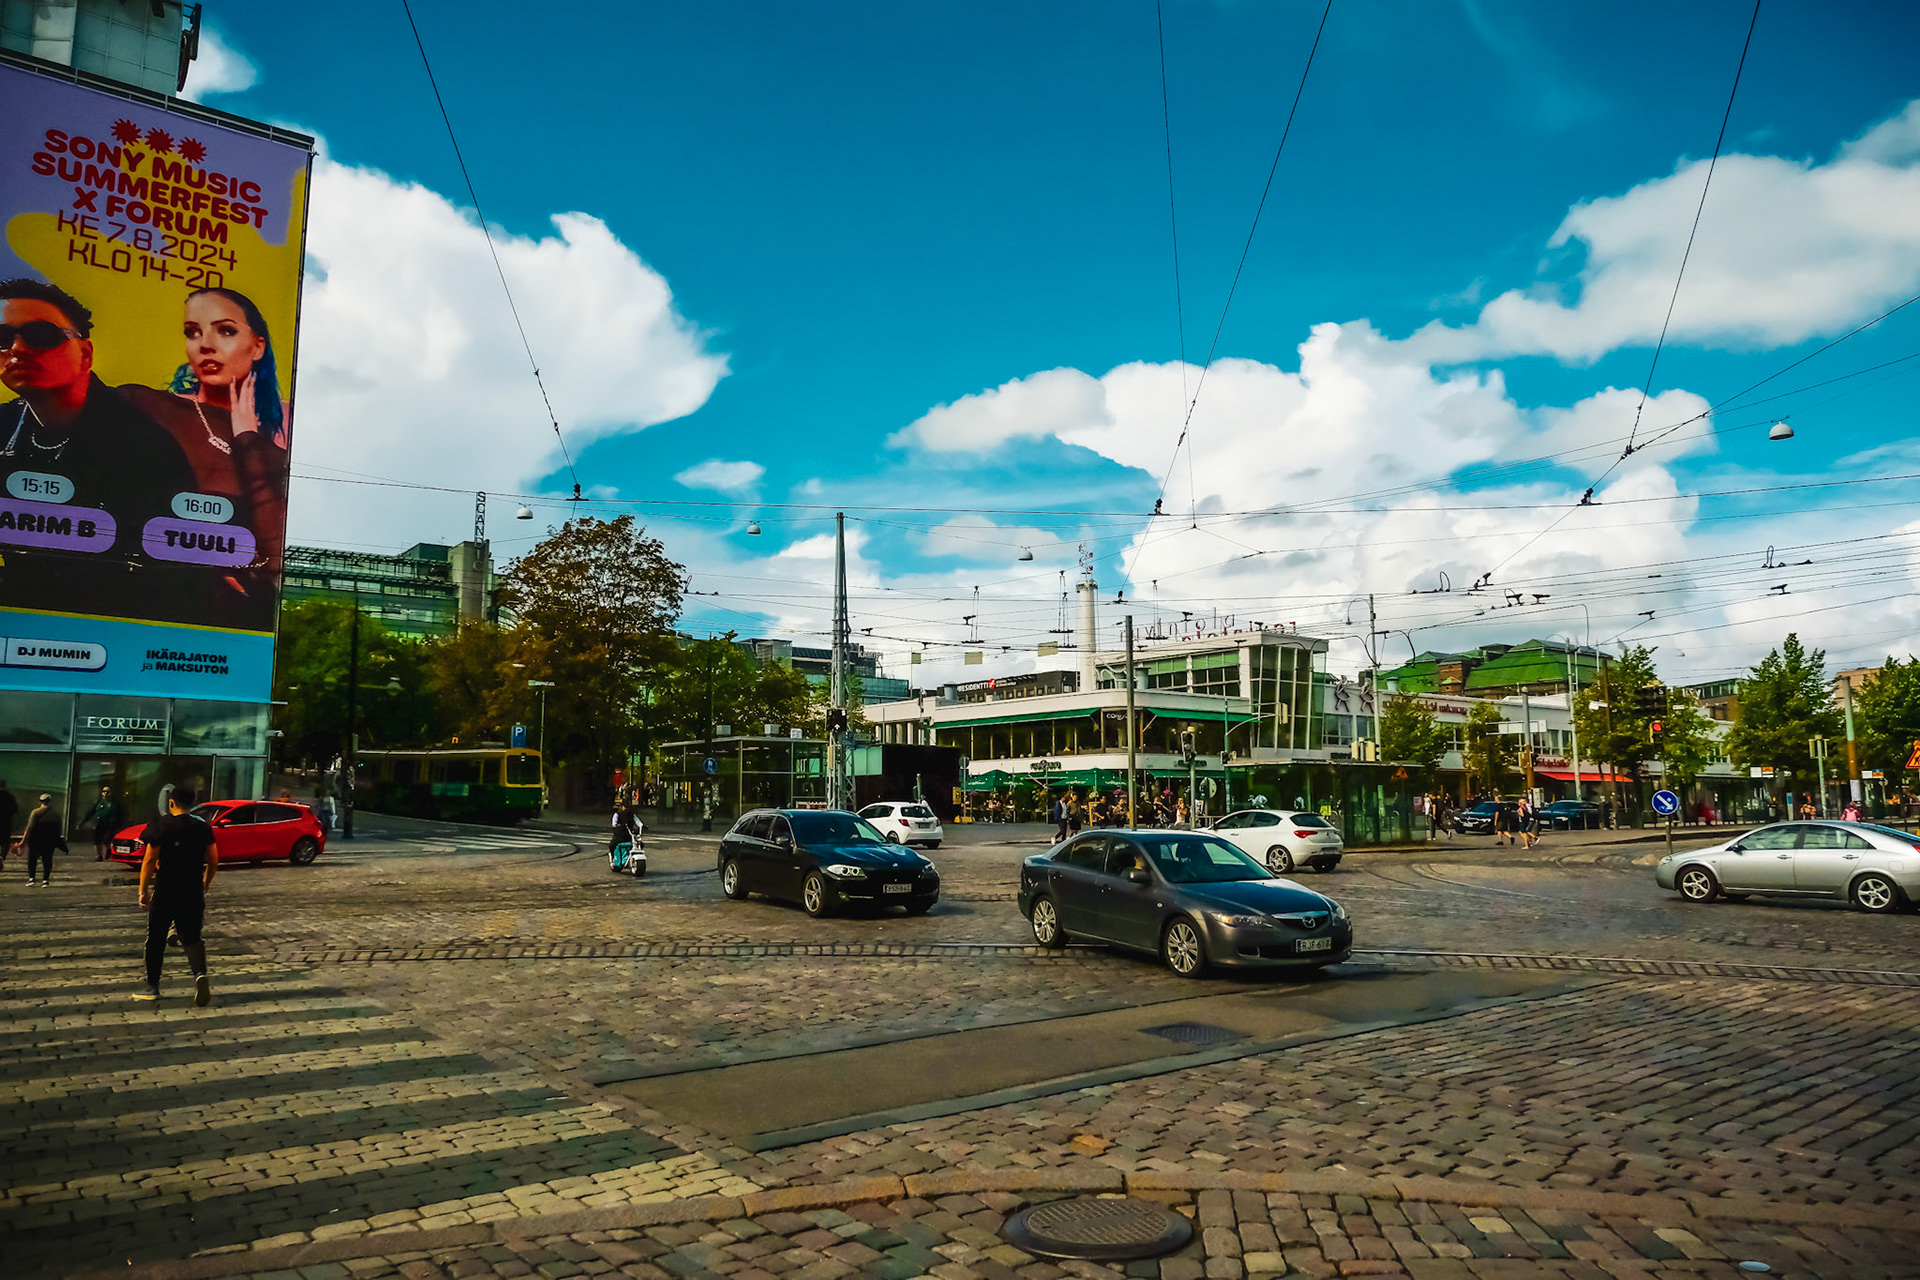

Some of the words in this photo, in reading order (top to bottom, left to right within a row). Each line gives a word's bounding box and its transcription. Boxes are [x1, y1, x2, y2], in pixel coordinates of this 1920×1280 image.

[44, 129, 145, 173] SONY
[152, 156, 262, 204] MUSIC
[31, 151, 269, 229] SUMMERFEST
[73, 186, 98, 213] X
[106, 195, 229, 245] FORUM
[57, 209, 100, 241] KE
[107, 221, 238, 271] 7.8.2024
[68, 239, 131, 273] KLO
[138, 255, 224, 289] 14-20
[22, 477, 60, 495] 15:15
[184, 498, 222, 516] 16:00
[77, 520, 97, 538] B
[164, 529, 236, 554] TUULI
[18, 646, 36, 657] DJ
[39, 647, 91, 660] MUMIN
[146, 648, 228, 664] IKÄRAJATON
[141, 662, 153, 672] ja
[155, 662, 229, 675] MAKSUTON
[87, 716, 158, 730] FORUM
[515, 727, 524, 737] P
[110, 734, 124, 743] 20
[126, 734, 134, 743] B
